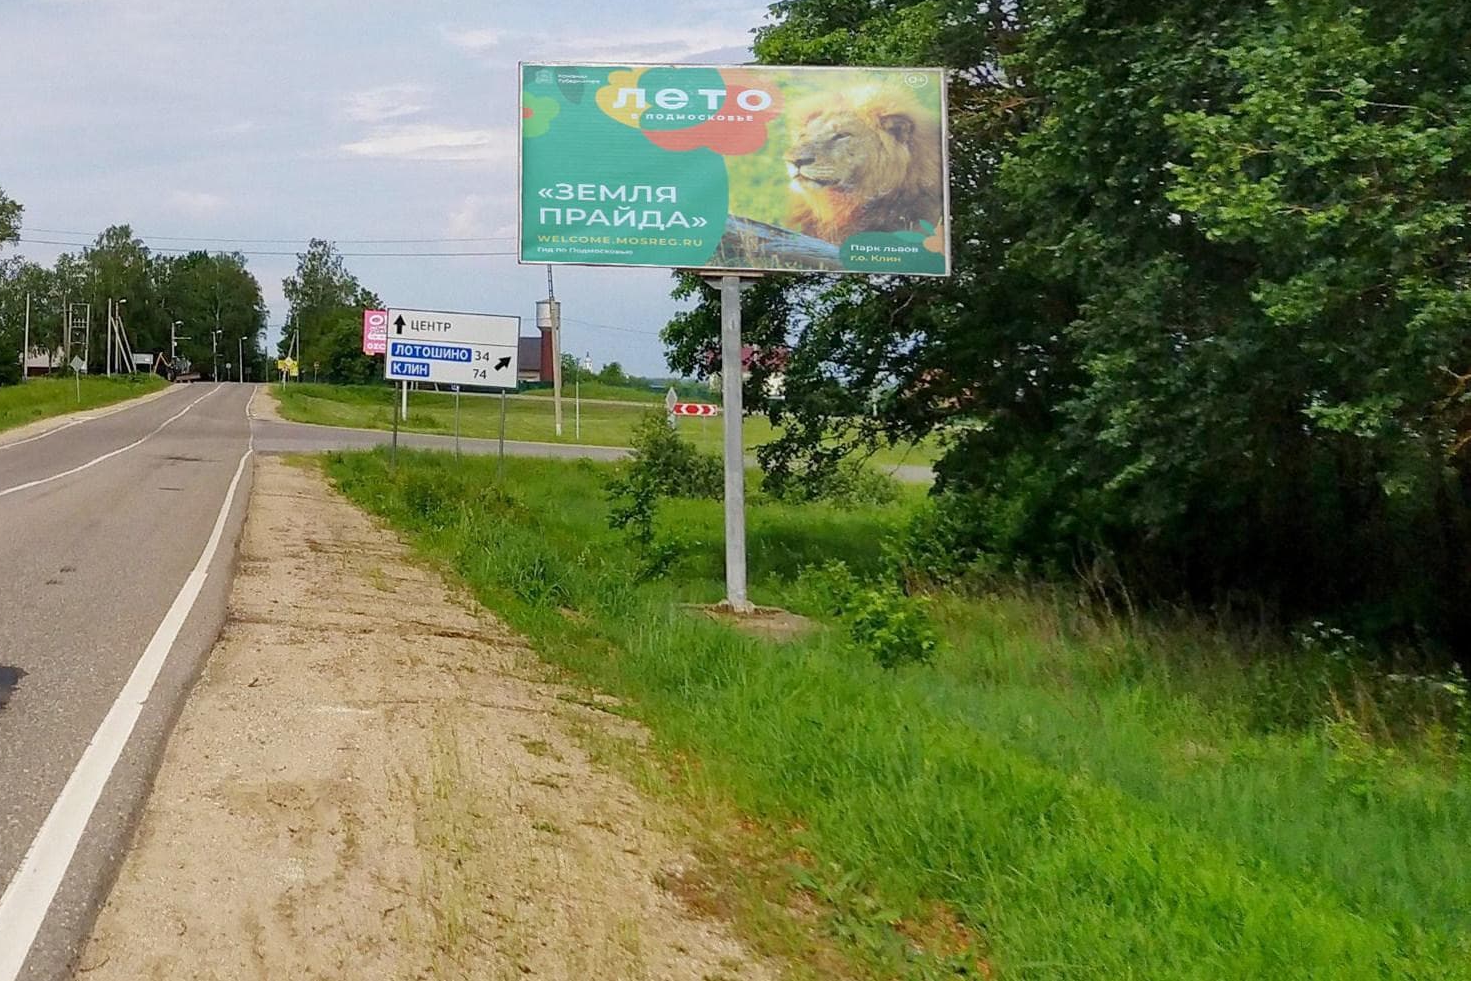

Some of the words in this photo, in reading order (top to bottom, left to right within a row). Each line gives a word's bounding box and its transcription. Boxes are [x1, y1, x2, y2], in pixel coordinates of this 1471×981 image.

[538, 183, 677, 203] «ЗЕМЛЯ
[539, 205, 707, 231] ПРАЙДА»
[537, 235, 703, 247] WELCOME.MOSREG.RU
[850, 244, 881, 253] Парк
[871, 254, 901, 263] Клин
[411, 320, 452, 332] ЦЕНТР
[395, 344, 469, 360] ЛОТОШИНО
[474, 350, 490, 362] 34
[393, 363, 428, 375] КЛИН
[472, 368, 487, 379] 74
